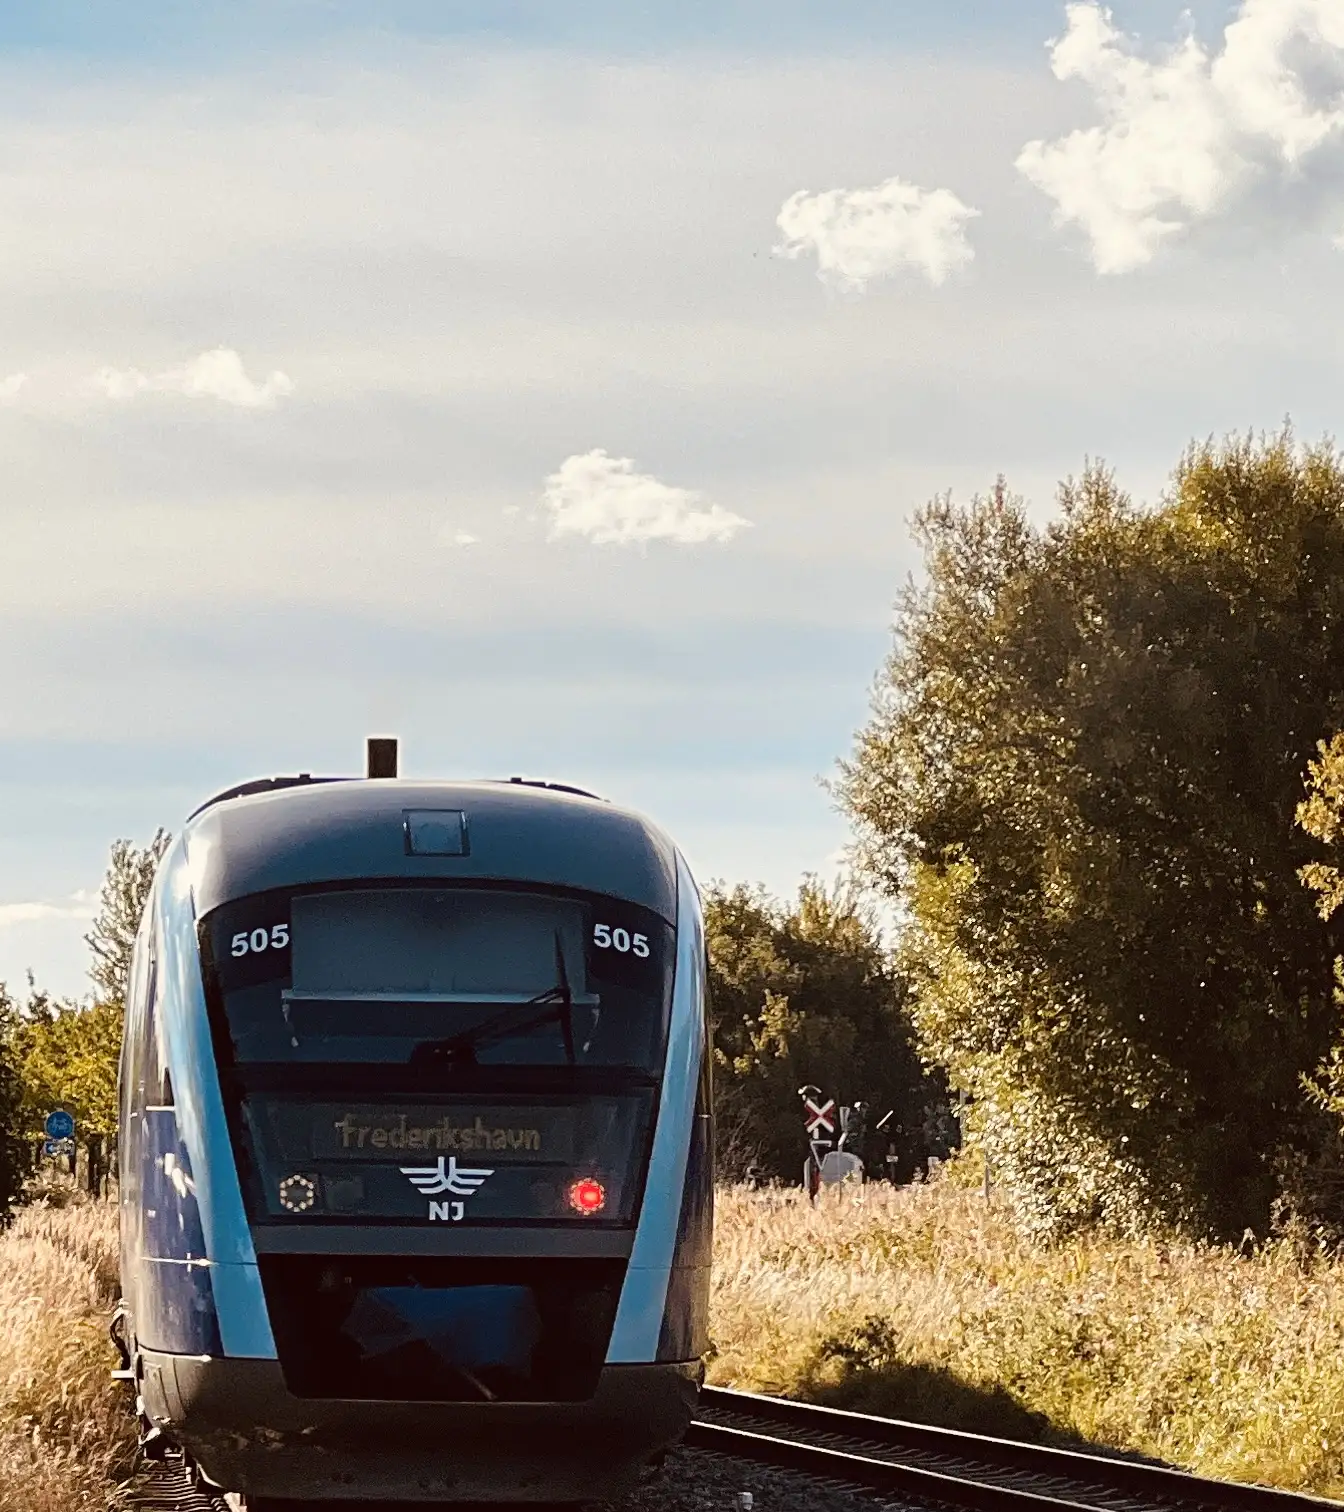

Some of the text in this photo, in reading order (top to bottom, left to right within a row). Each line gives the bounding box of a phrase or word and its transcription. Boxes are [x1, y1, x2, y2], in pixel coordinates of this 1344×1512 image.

[231, 923, 290, 958] 505
[593, 923, 651, 958] 505
[428, 1201, 465, 1221] NJ
